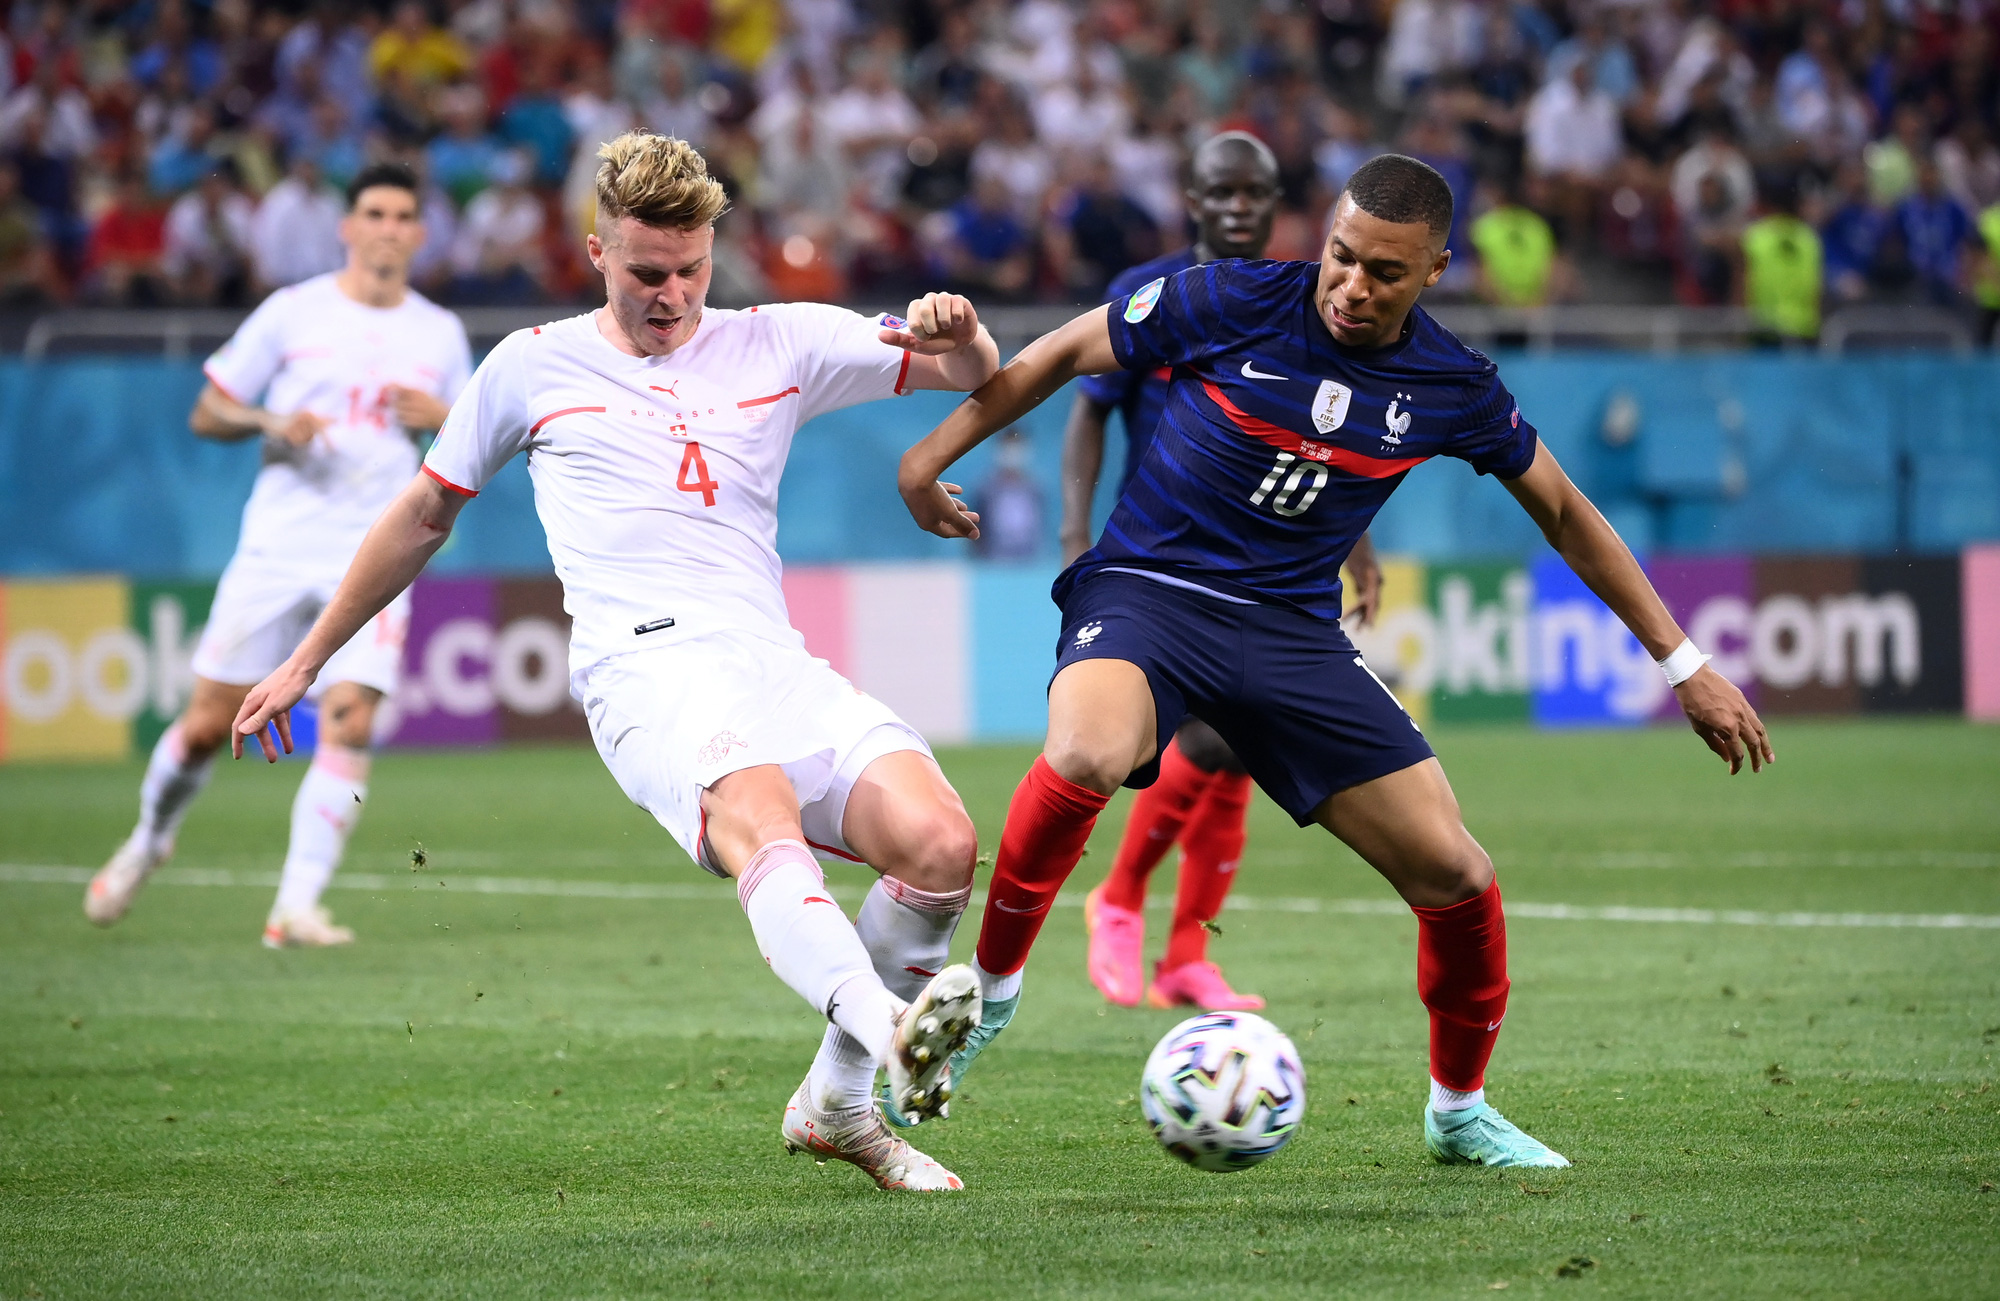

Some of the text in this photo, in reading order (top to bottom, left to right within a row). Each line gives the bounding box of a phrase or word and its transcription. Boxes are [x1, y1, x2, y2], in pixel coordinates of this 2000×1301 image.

[1320, 413, 1335, 423] FIFA
[677, 441, 718, 507] 4
[1249, 450, 1329, 517] 10
[1349, 574, 1921, 717] okingcom
